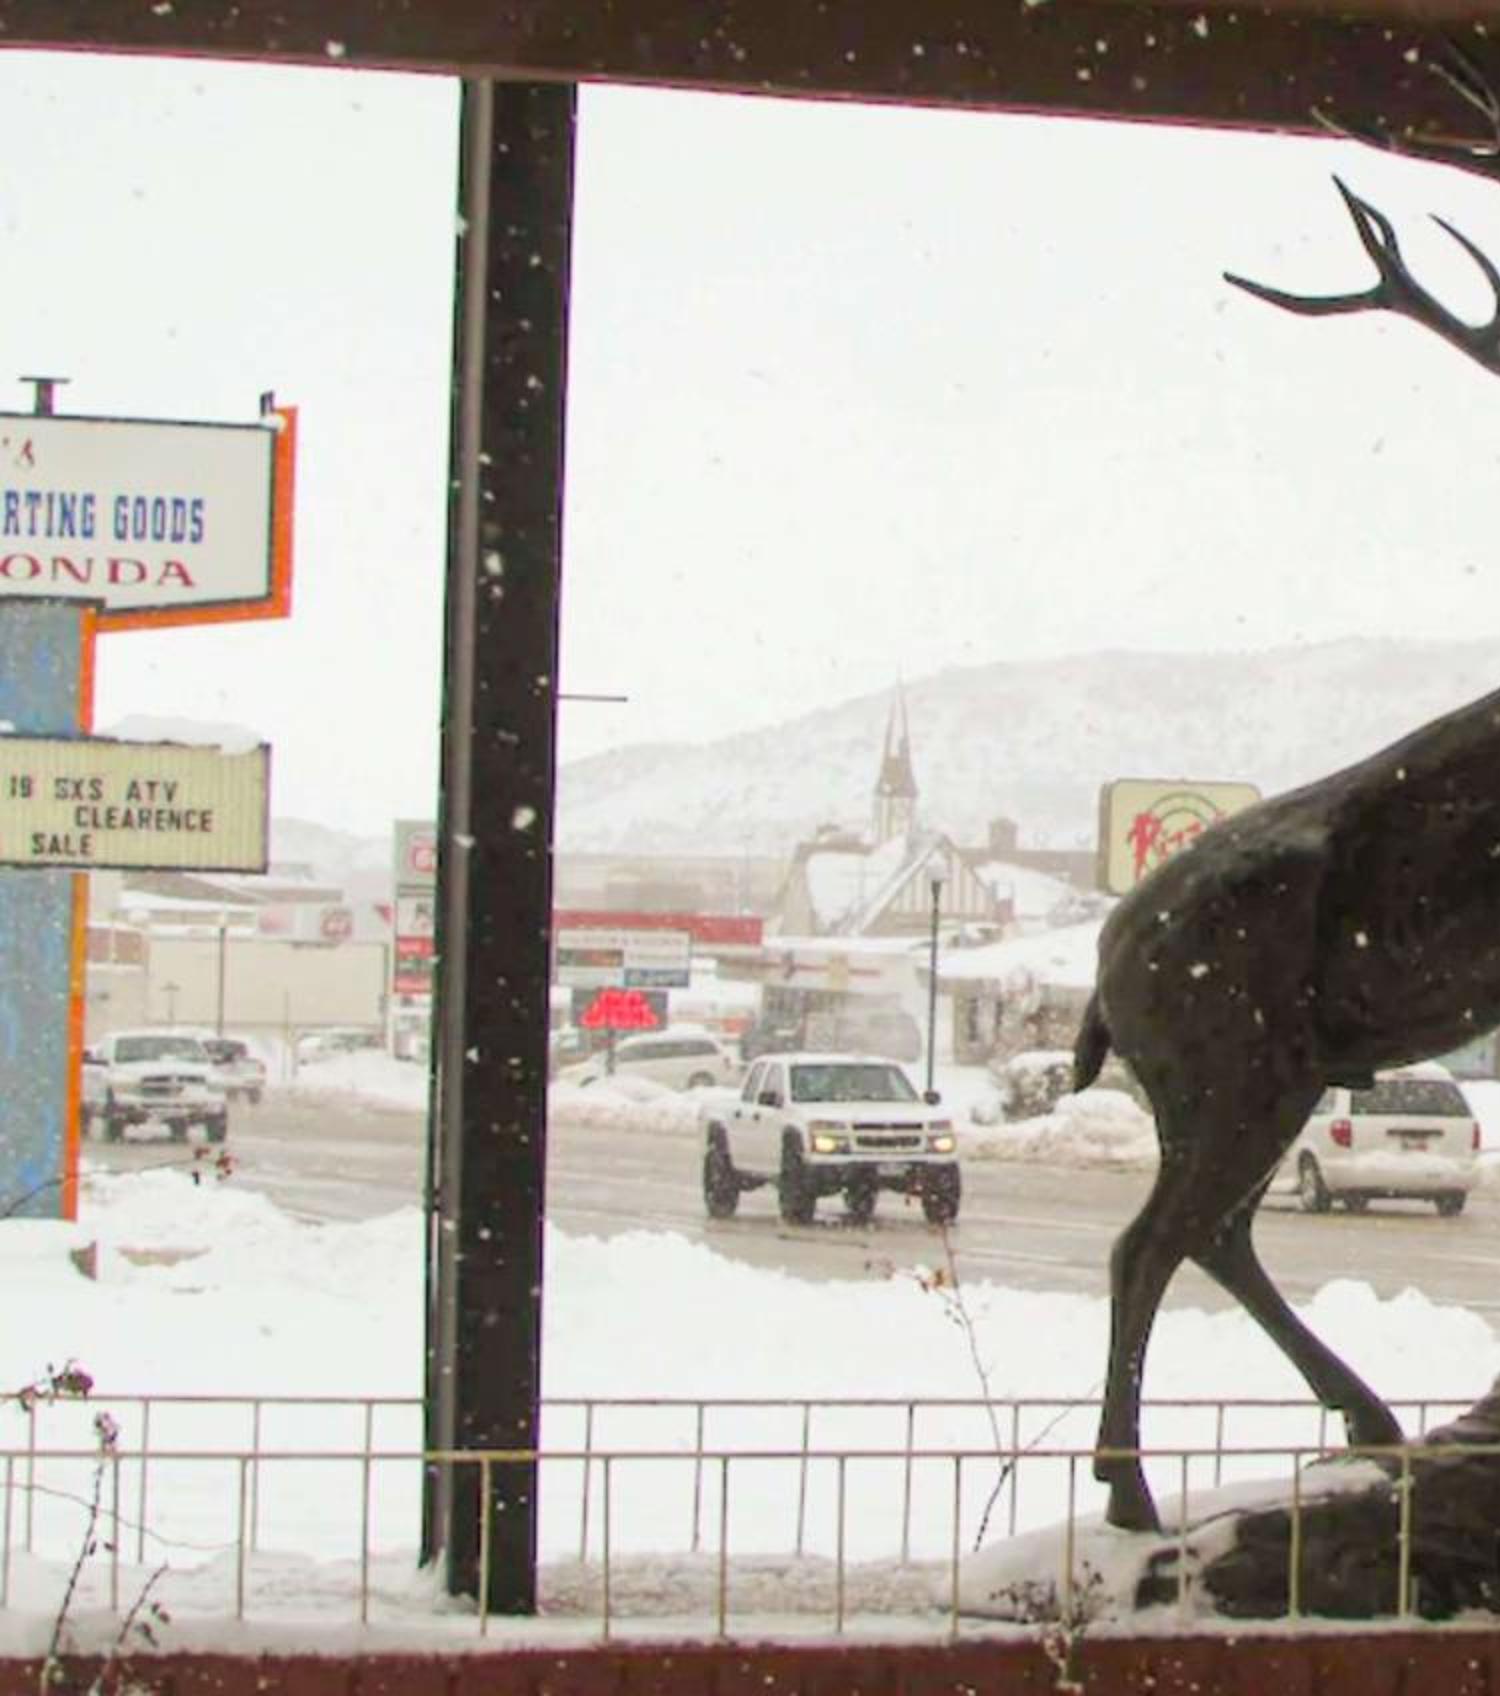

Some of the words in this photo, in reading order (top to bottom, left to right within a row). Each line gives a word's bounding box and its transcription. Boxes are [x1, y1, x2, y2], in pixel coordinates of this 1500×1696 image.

[3, 489, 96, 540] RTING
[113, 494, 206, 545] GOODS
[0, 552, 196, 589] ONDA
[54, 777, 103, 801] SXS
[127, 779, 179, 803] ATV
[75, 806, 214, 833] CLEARENCE
[31, 832, 92, 857] SALE
